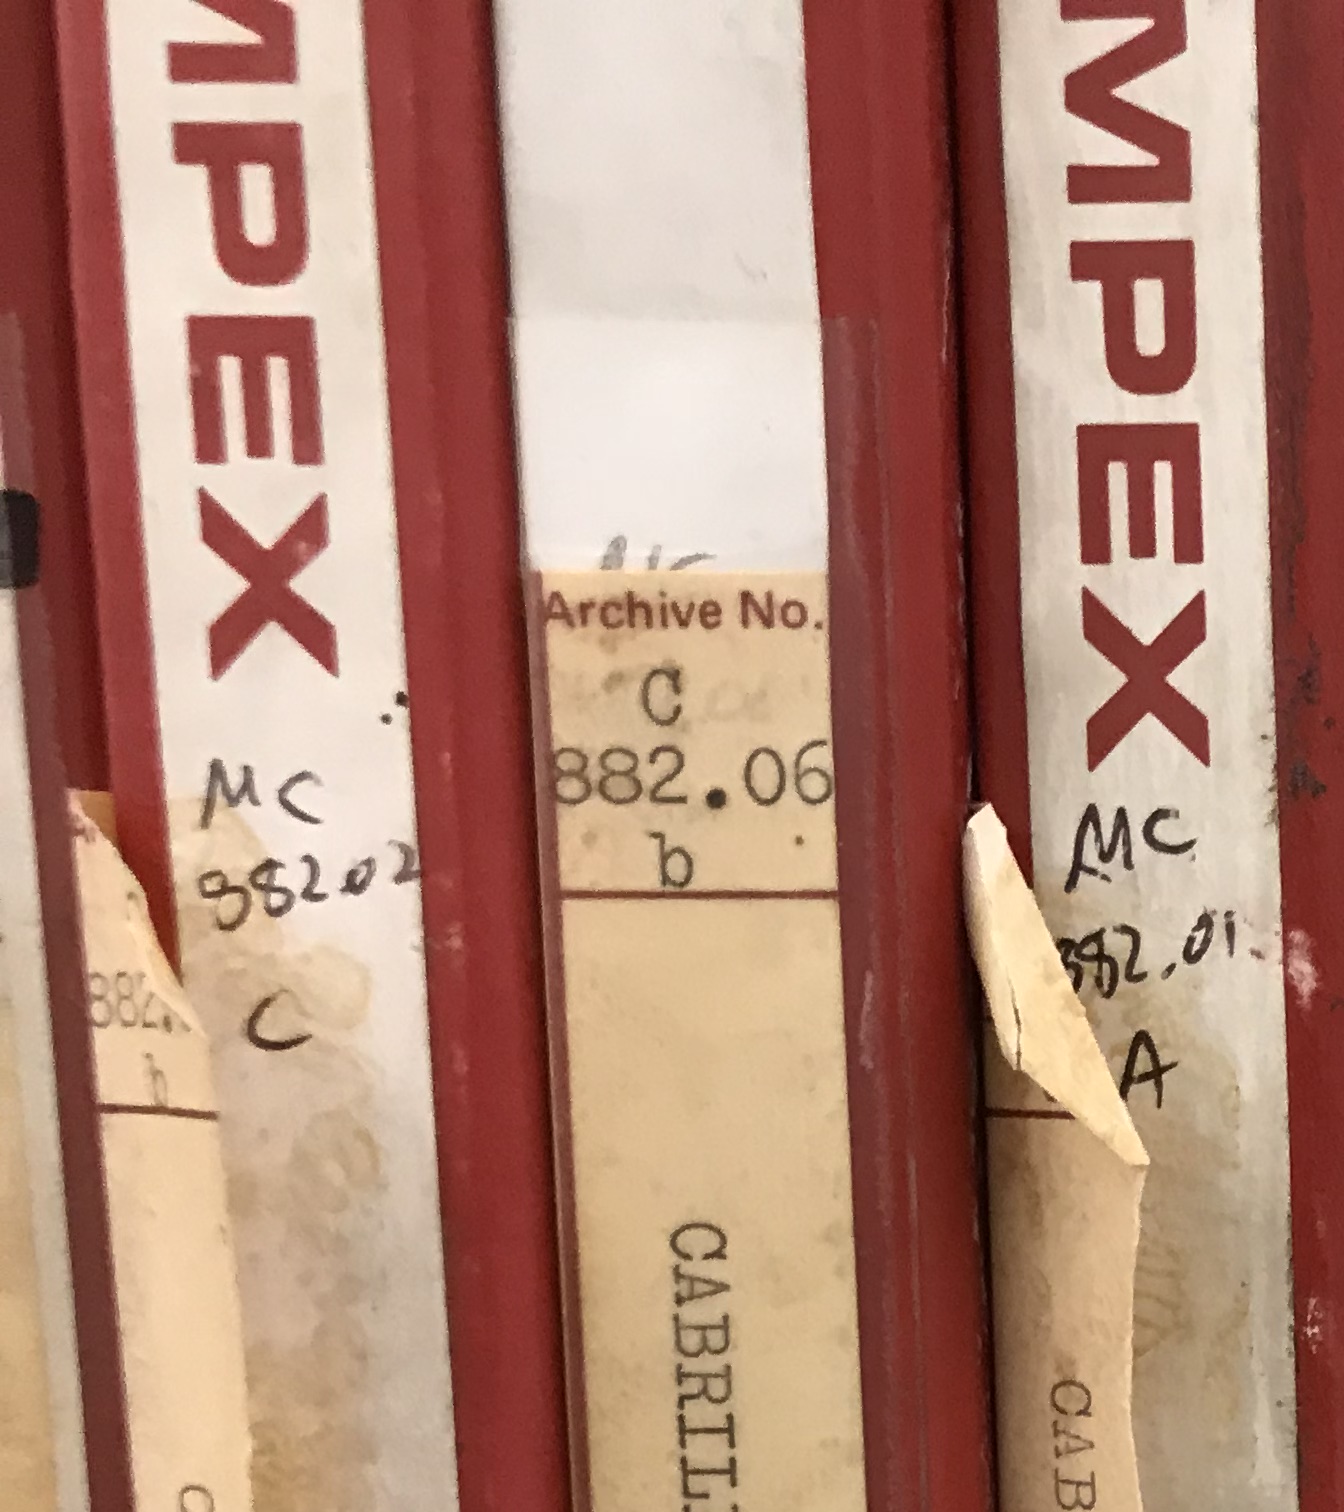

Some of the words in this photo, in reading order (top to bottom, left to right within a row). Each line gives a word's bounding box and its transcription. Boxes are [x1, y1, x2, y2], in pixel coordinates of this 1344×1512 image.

[543, 588, 724, 631] Archive
[741, 590, 825, 633] No.
[640, 666, 684, 728] C
[200, 758, 325, 830] MC
[553, 740, 836, 811] 882.06
[650, 830, 694, 890] b
[1064, 801, 1198, 894] MC
[1118, 1029, 1180, 1110] A
